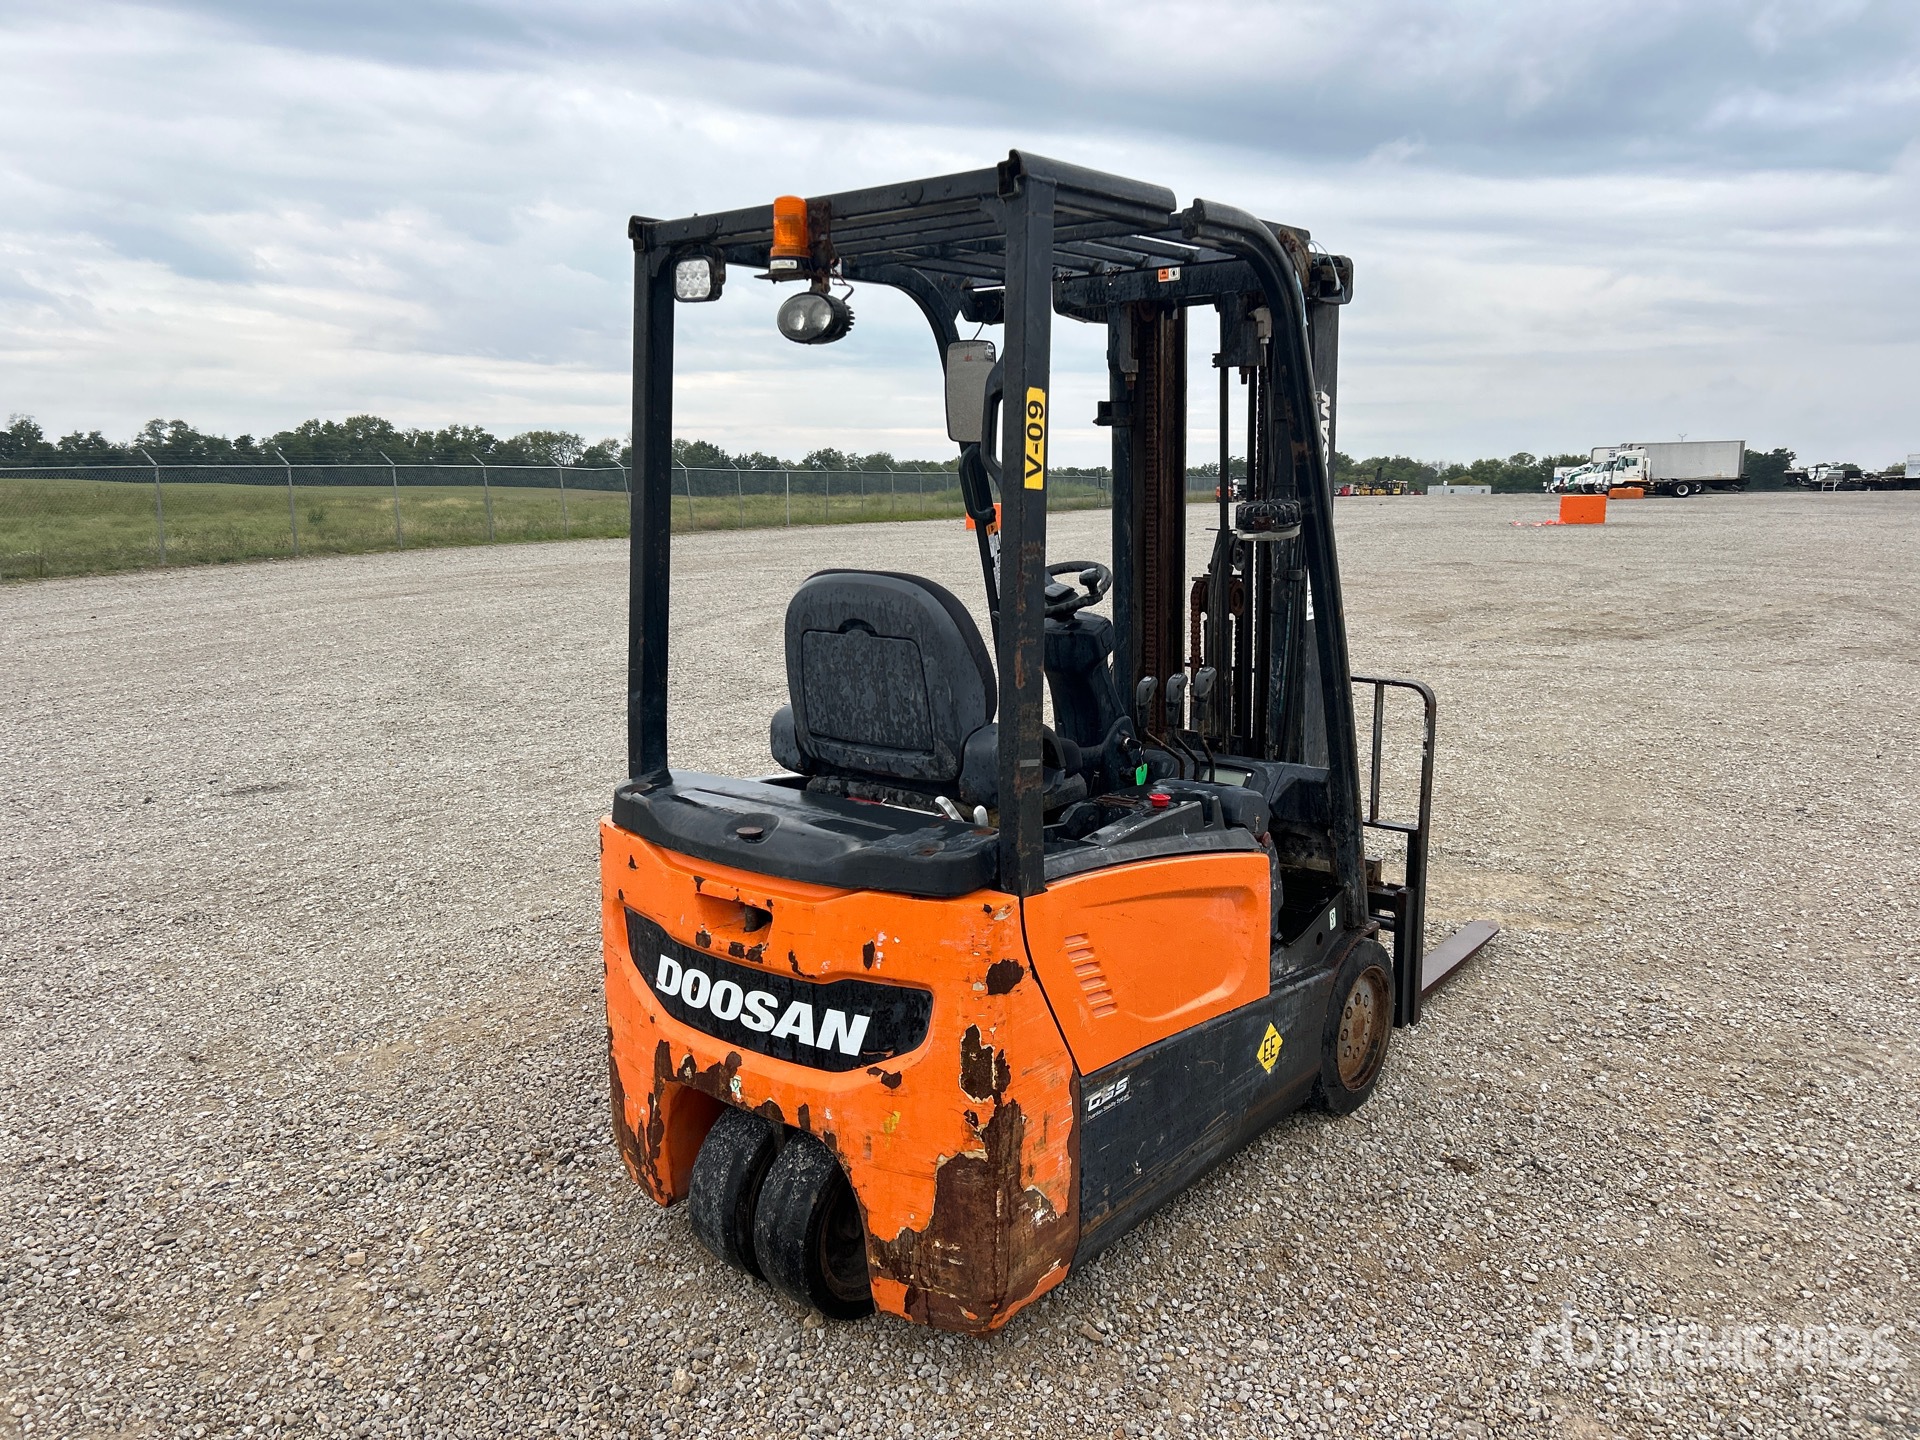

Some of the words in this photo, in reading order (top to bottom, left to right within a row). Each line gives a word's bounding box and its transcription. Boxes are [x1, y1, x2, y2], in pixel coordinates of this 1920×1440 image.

[1026, 400, 1044, 479] V-09
[655, 953, 870, 1057] DOOSAN
[1263, 1034, 1277, 1063] EE
